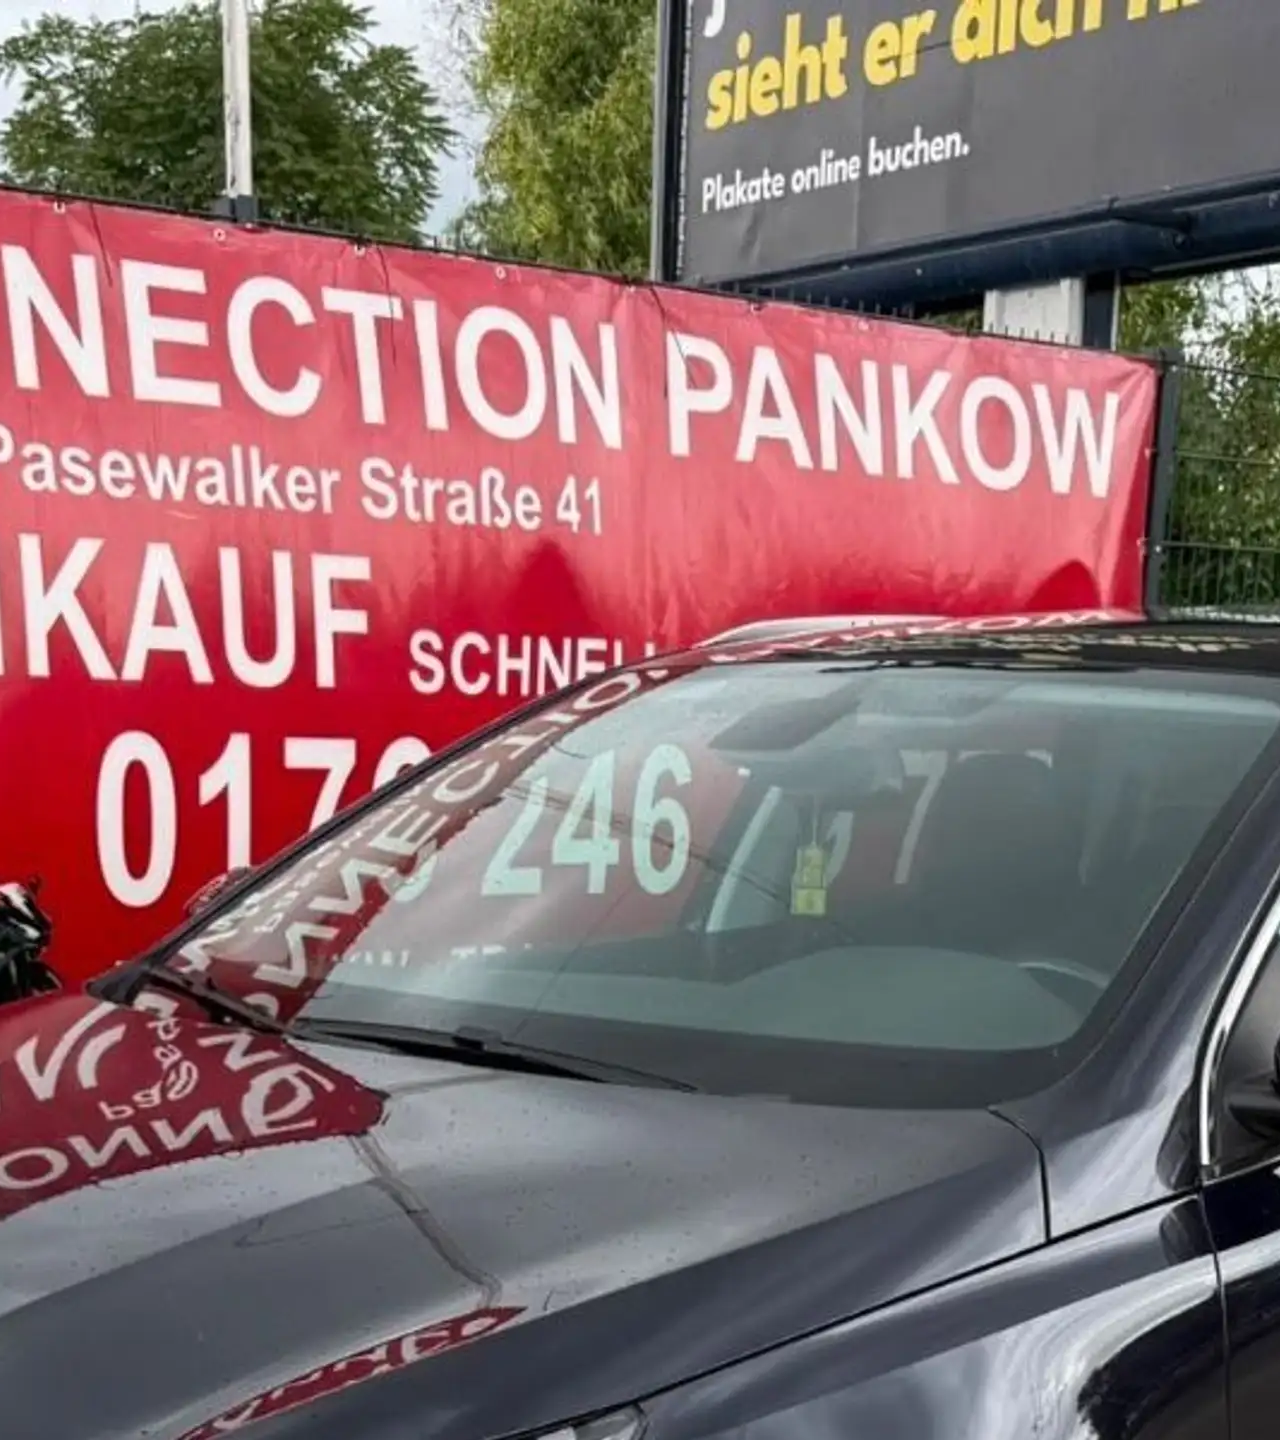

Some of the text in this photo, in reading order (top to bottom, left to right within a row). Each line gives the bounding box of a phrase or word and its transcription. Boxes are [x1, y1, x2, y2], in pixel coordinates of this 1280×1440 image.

[705, 13, 848, 129] sieht
[863, 9, 937, 85] er
[701, 125, 970, 213] Plakate online buchen.
[666, 330, 1120, 499] PANKOW
[360, 456, 542, 532] Straße
[556, 474, 603, 536] 41
